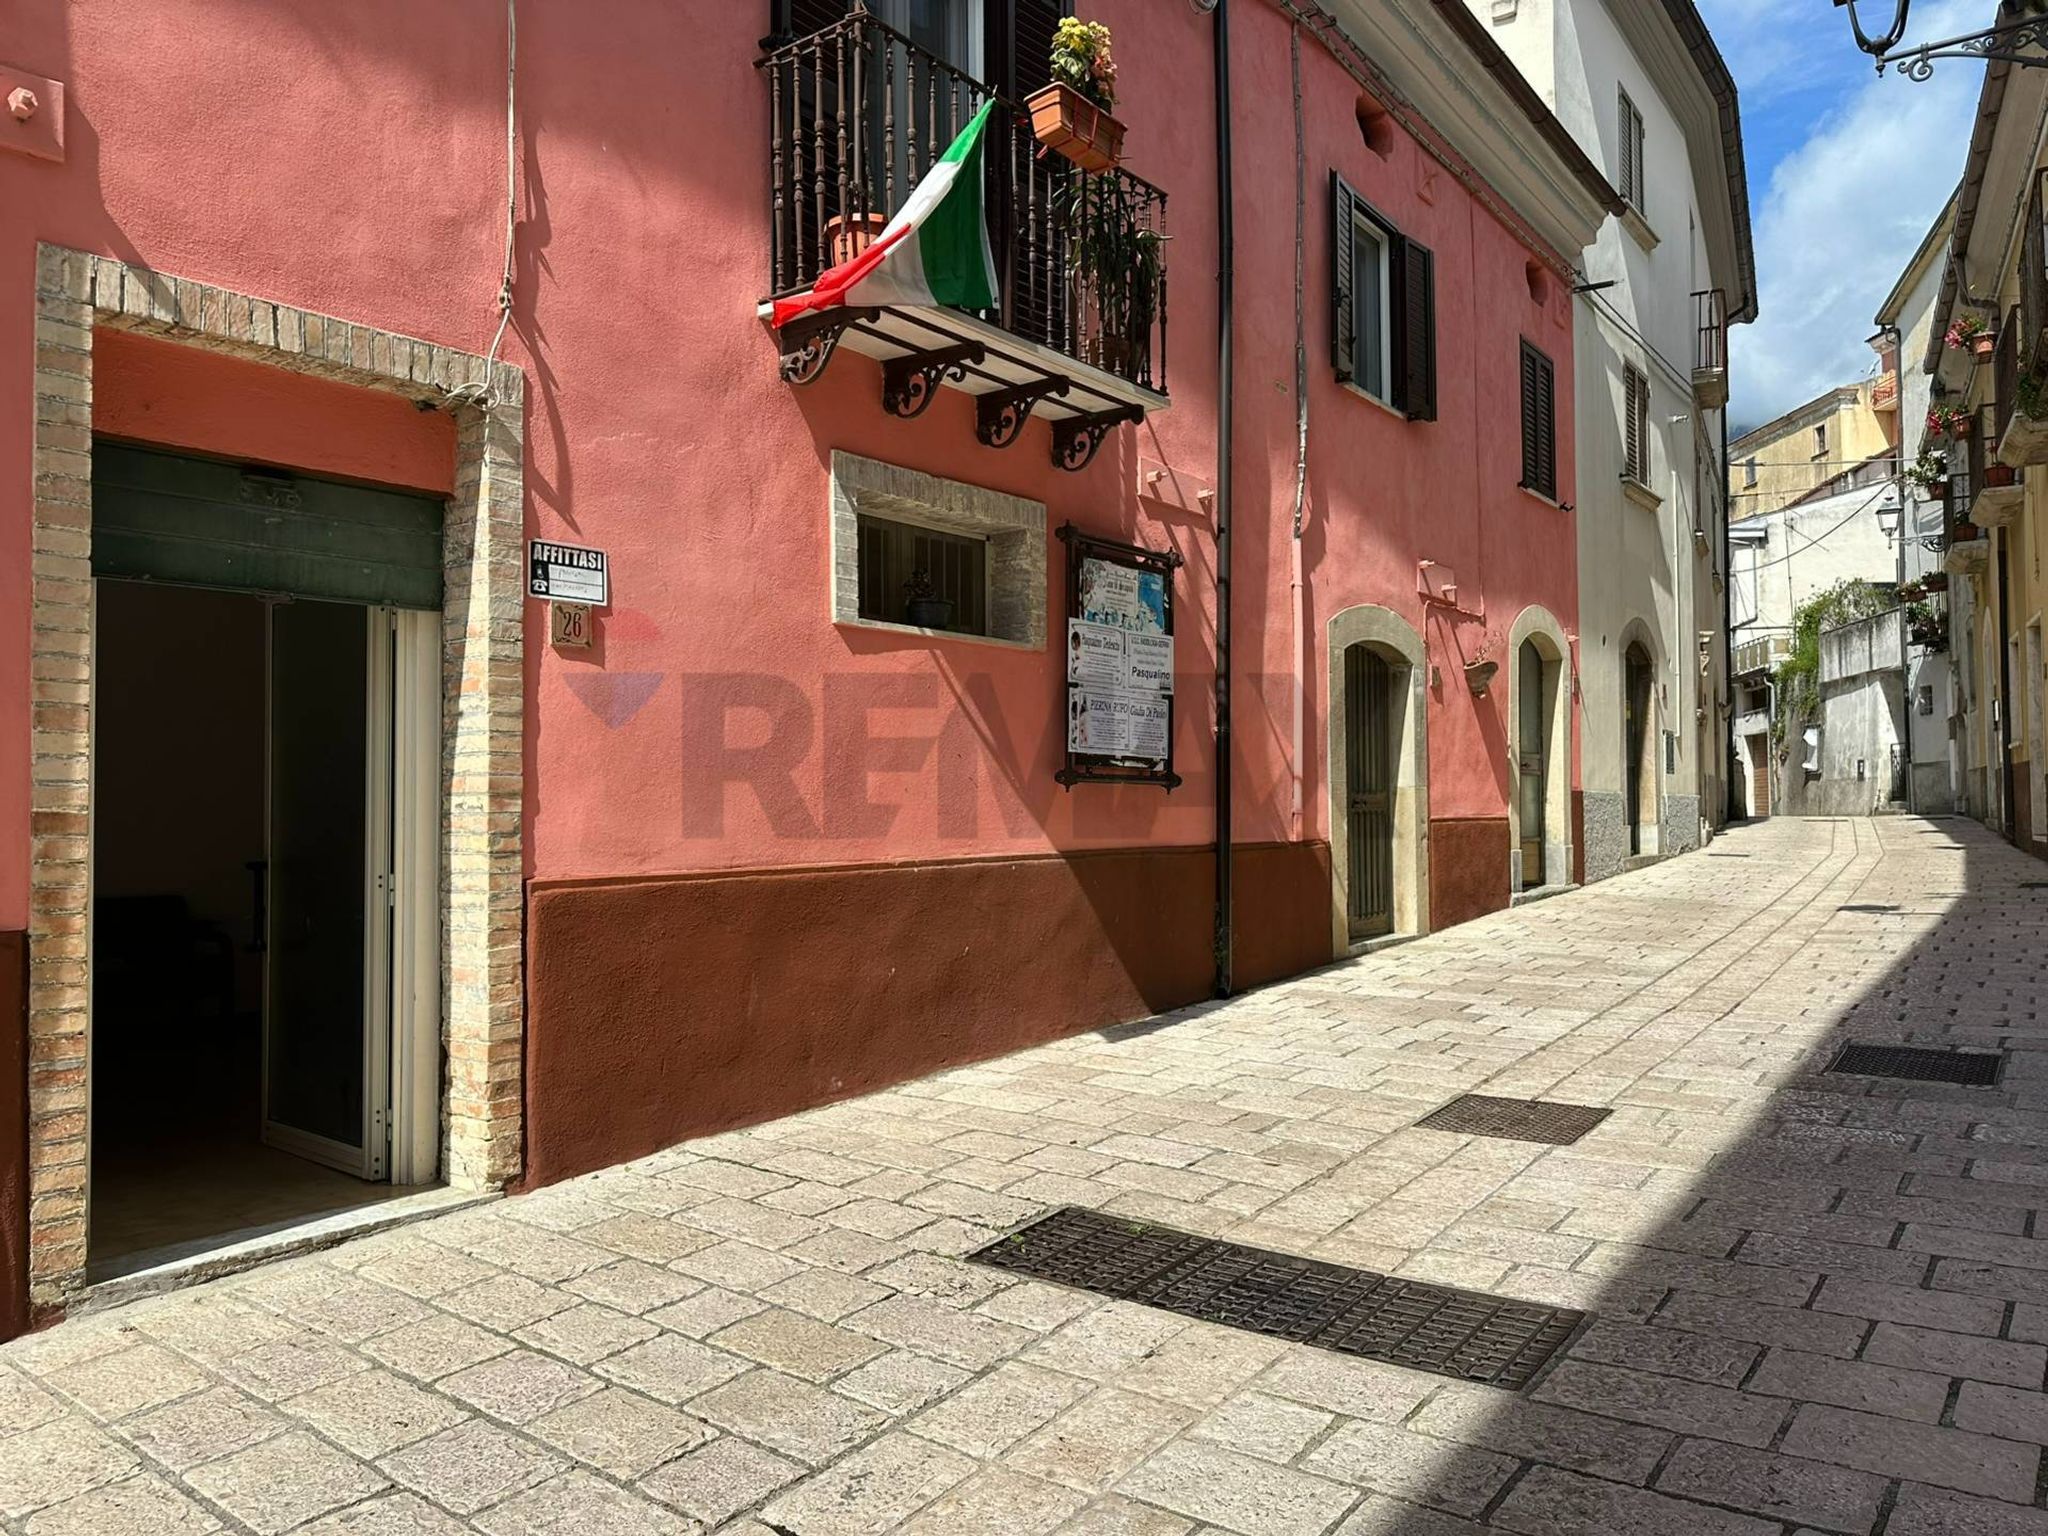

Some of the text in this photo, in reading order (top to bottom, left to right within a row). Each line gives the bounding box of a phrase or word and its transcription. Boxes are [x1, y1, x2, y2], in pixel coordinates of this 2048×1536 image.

[533, 544, 602, 569] AFFITTASI
[563, 611, 582, 638] 26
[1131, 666, 1170, 680] Pasqualino
